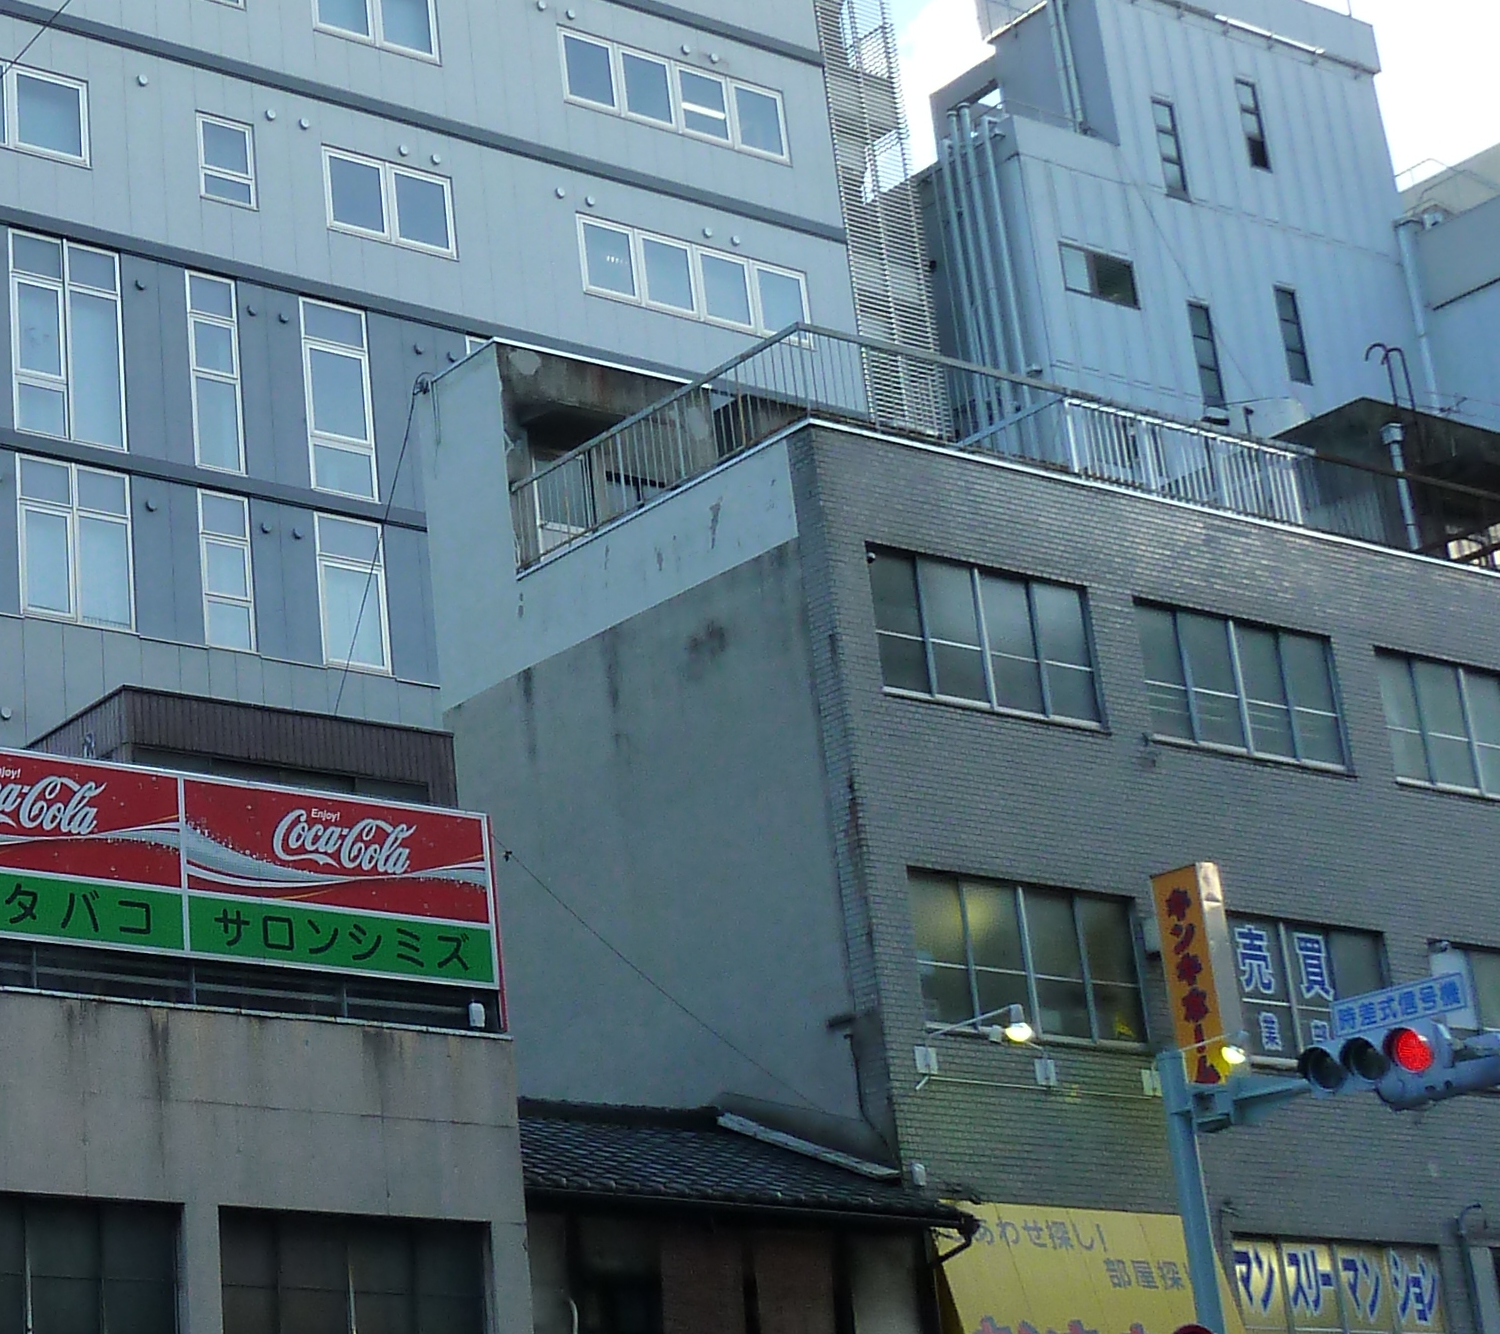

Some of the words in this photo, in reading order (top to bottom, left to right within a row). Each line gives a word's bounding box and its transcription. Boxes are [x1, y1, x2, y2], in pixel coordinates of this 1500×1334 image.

[272, 808, 417, 875] Coca-Cola
[310, 807, 341, 822] Enjoy!
[214, 907, 470, 972] サロンシミズ
[1233, 924, 1334, 1001] 売買
[1165, 887, 1221, 1084] キンキホーム
[1337, 979, 1462, 1030] 時差式信号機
[1104, 1257, 1189, 1291] 部屋探
[1233, 1247, 1438, 1324] マンスリーマンション
